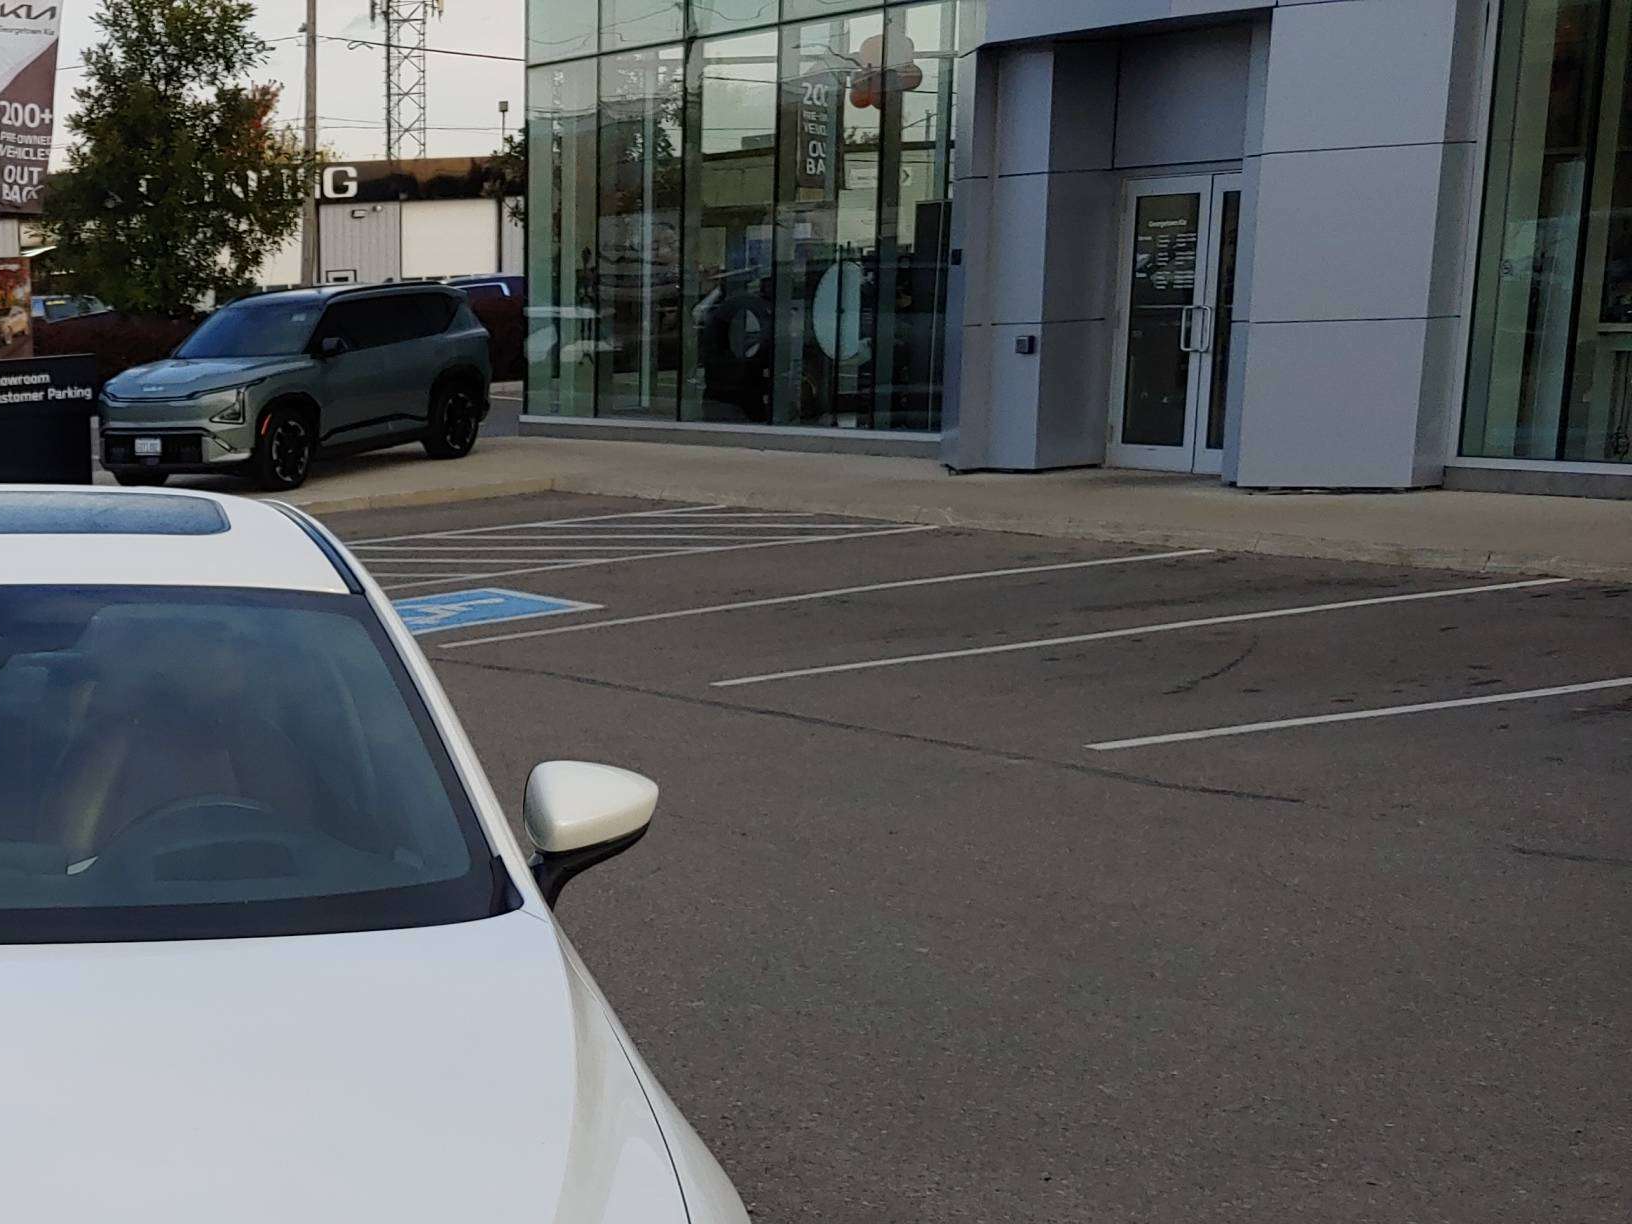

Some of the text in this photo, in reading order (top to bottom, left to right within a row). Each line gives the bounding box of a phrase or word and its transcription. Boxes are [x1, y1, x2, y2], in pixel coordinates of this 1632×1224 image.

[0, 3, 57, 20] KIA
[0, 100, 53, 128] 200+
[3, 164, 44, 185] OUT
[47, 386, 93, 400] Parking
